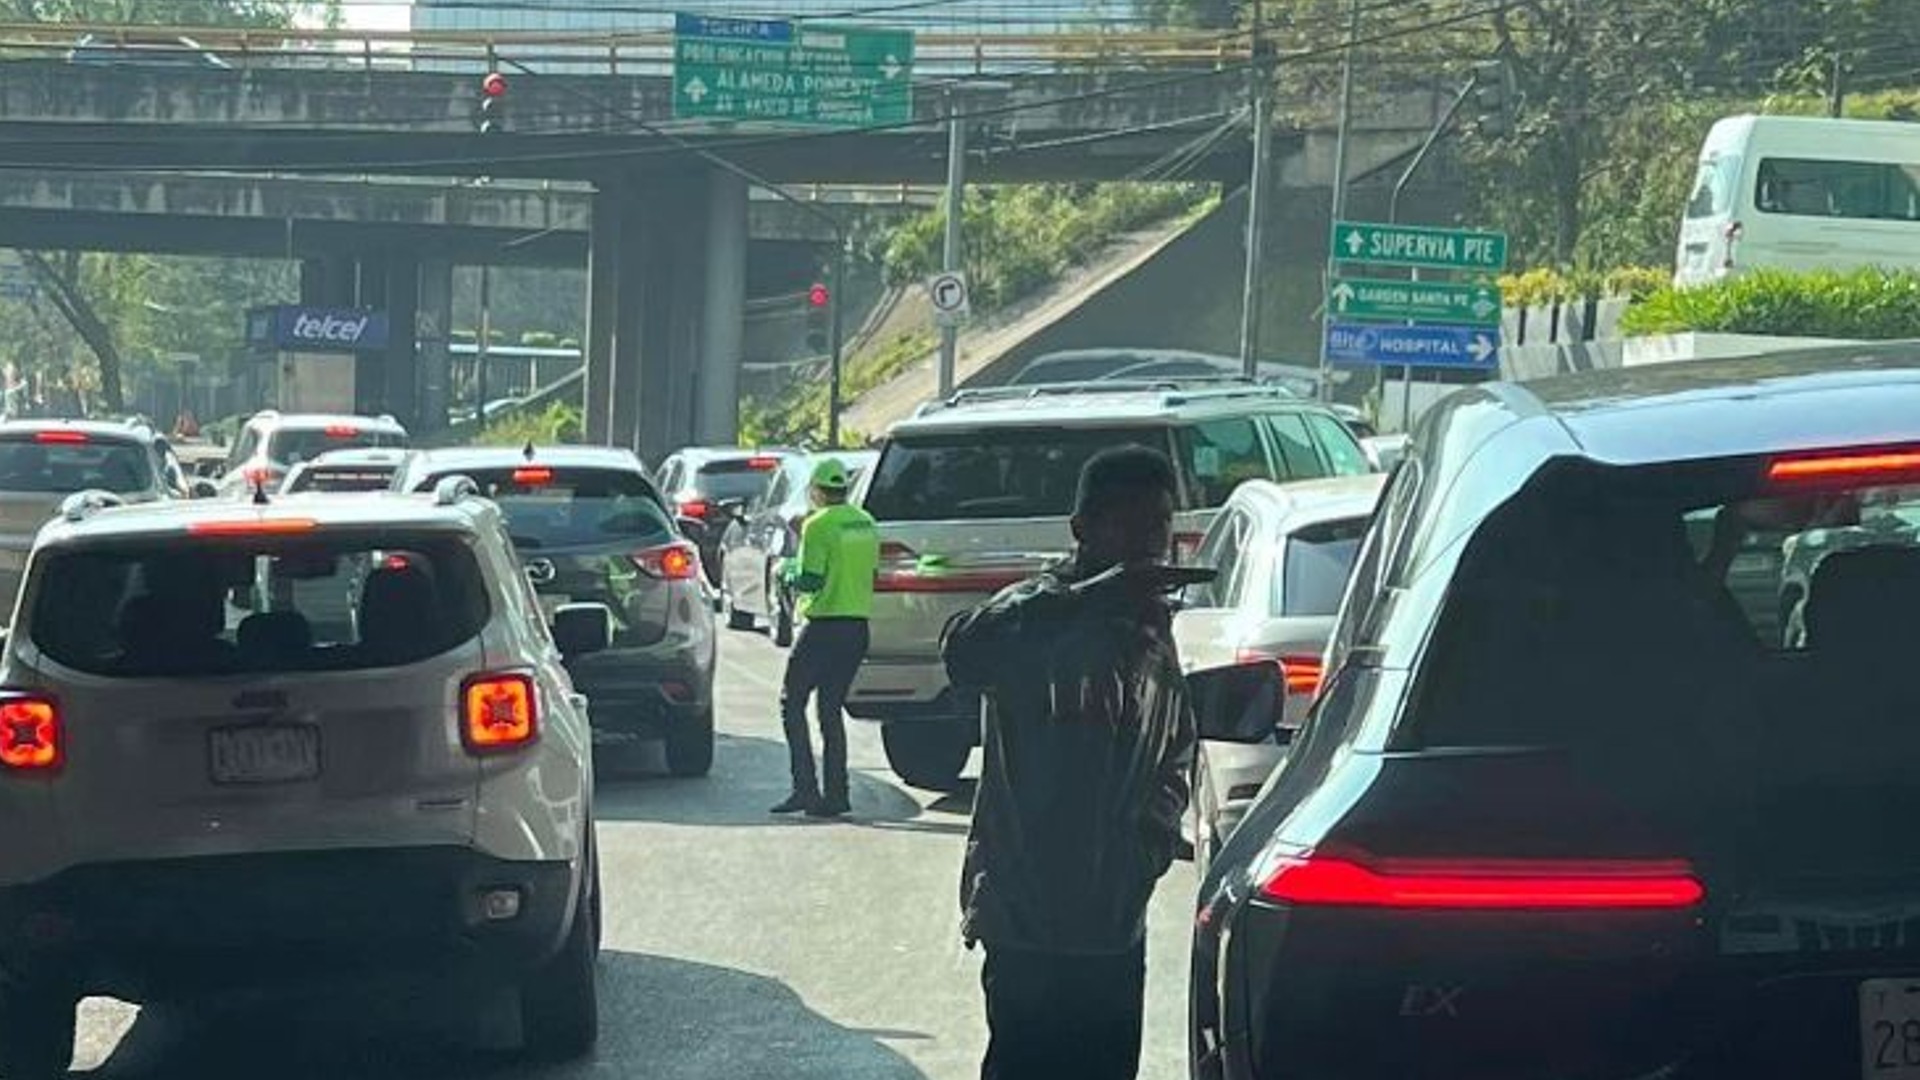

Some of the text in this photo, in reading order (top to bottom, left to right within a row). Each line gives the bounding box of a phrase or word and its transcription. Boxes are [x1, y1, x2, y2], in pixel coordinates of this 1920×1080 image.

[717, 69, 795, 94] ALAMEDA
[1370, 231, 1495, 264] SUPERVIA PTE
[293, 312, 368, 343] telcel
[1379, 338, 1461, 356] HOSPITAL
